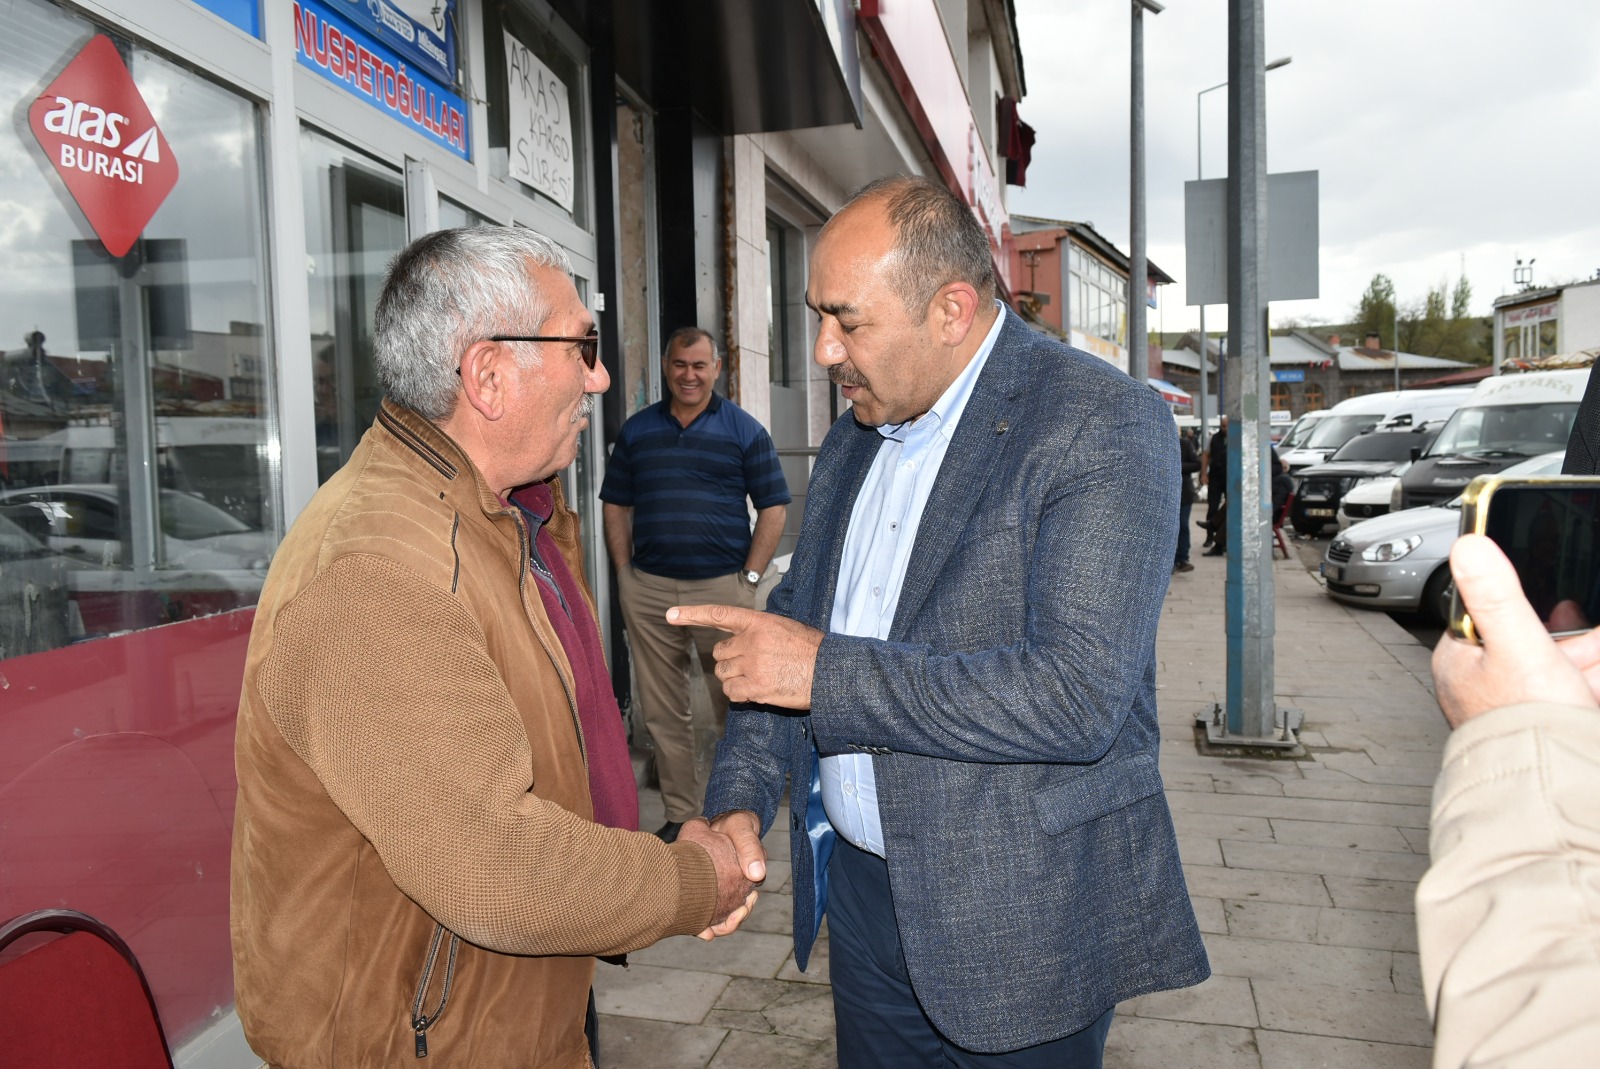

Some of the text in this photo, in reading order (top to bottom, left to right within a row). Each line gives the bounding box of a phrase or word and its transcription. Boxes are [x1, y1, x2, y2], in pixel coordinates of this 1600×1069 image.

[293, 2, 466, 153] NUSRETOĞULLARI
[510, 41, 560, 125] ARAS
[44, 97, 124, 148] aras
[529, 107, 569, 162] KARGO
[61, 144, 143, 184] BURASI
